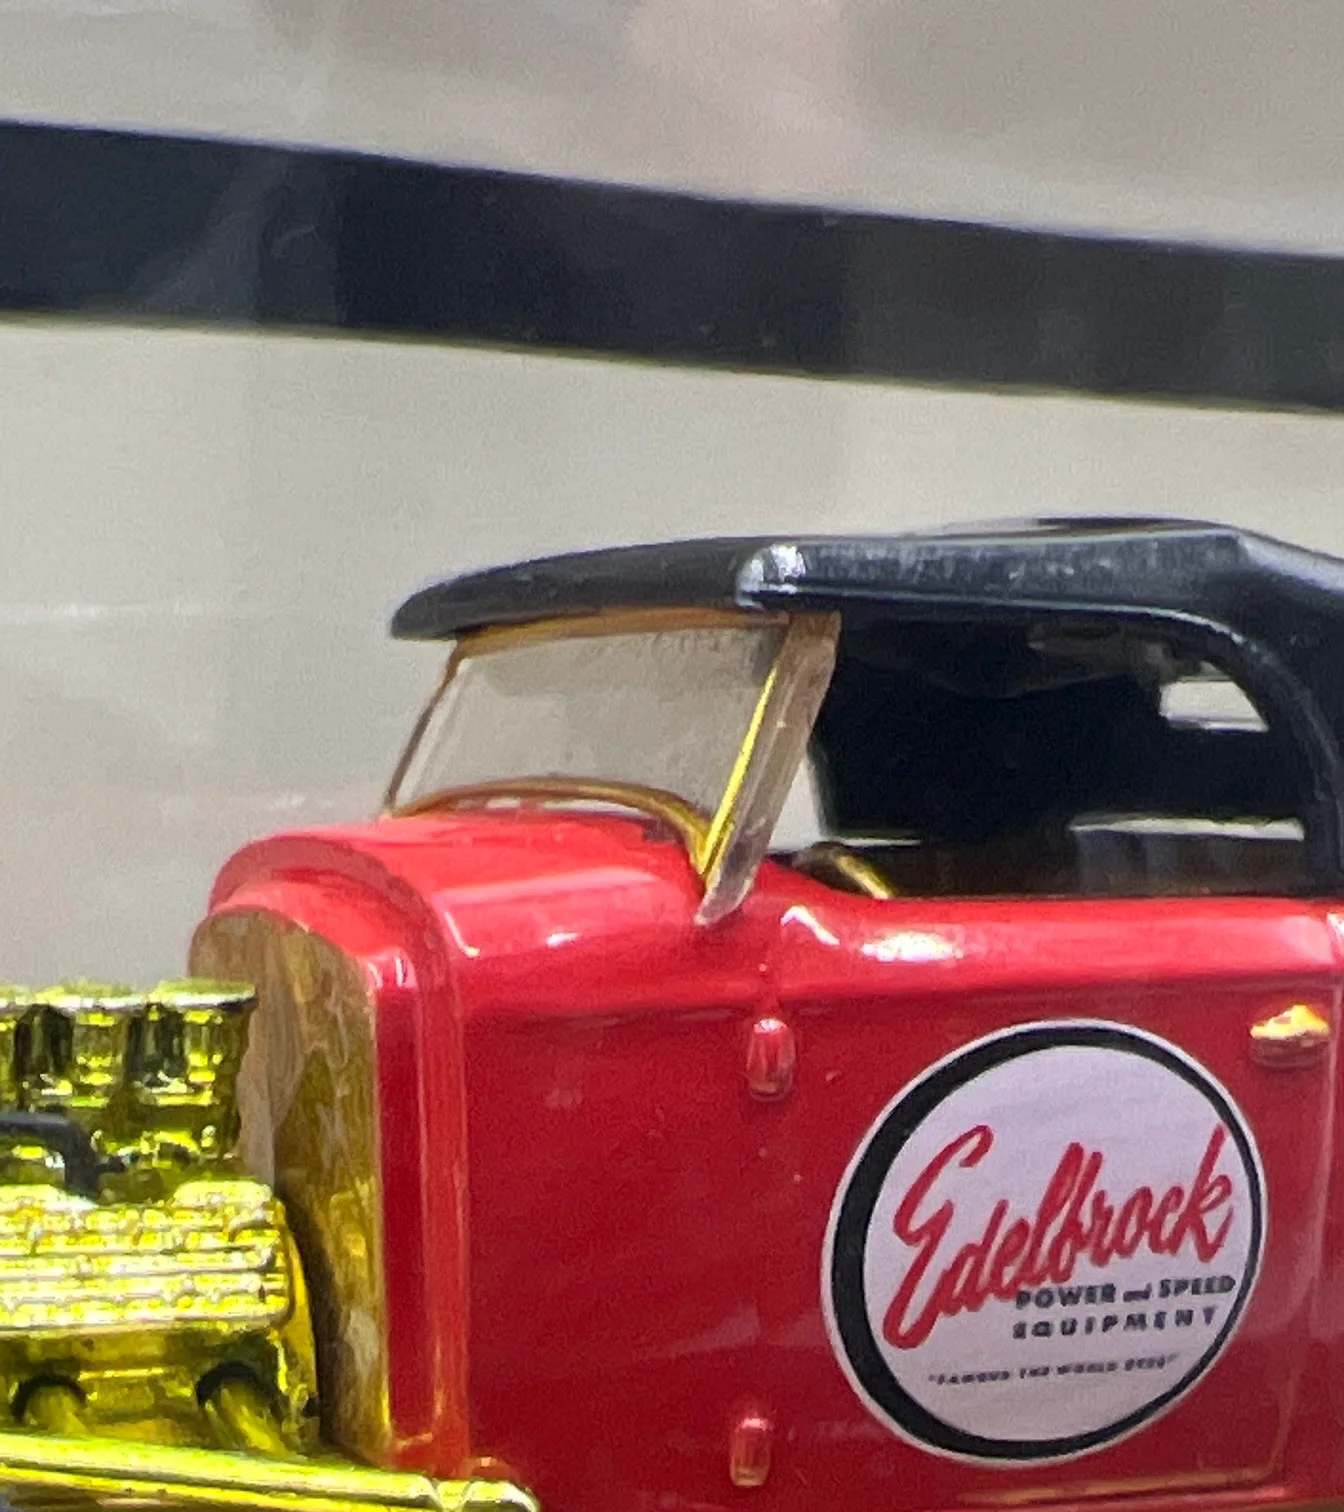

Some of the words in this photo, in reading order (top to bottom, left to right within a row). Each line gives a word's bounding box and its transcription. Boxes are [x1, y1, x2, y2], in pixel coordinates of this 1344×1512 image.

[883, 1124, 1233, 1349] Edelbrock
[1016, 1283, 1116, 1309] POWER
[1159, 1275, 1236, 1298] SPEED
[1012, 1305, 1217, 1340] EQUIPMENT
